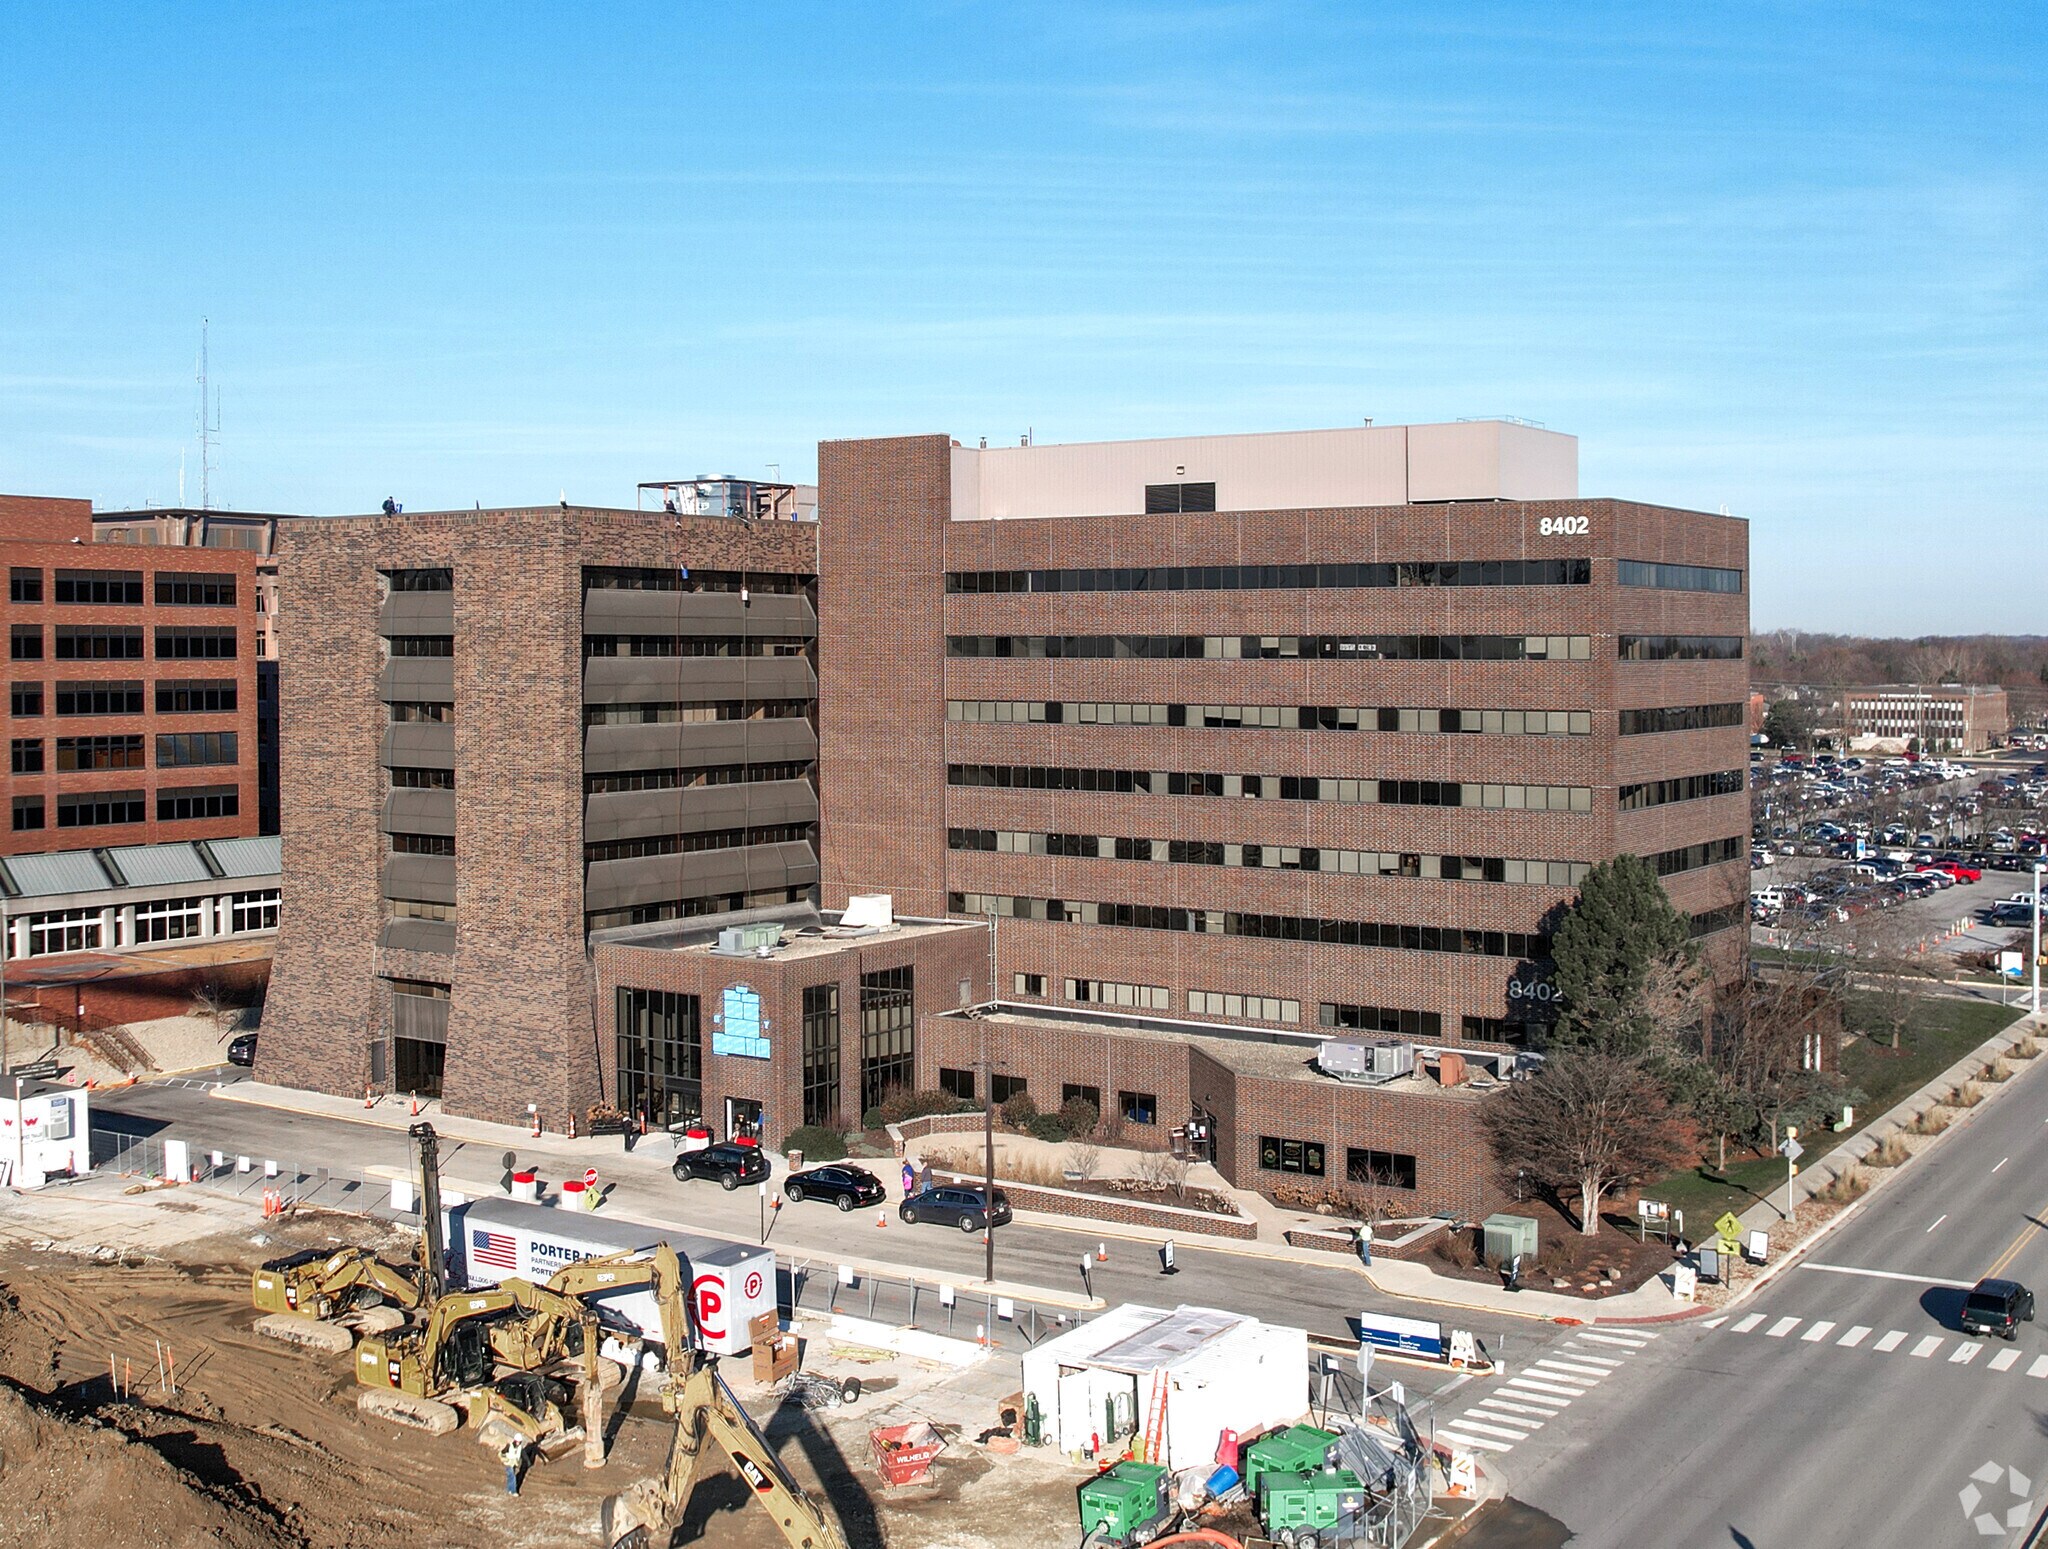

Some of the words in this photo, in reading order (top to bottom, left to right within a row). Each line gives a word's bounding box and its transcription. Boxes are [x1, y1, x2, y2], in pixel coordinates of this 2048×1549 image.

[1540, 516, 1589, 536] 8402
[531, 1242, 580, 1261] PORTER
[700, 1290, 722, 1322] P
[743, 1460, 764, 1487] CAT
